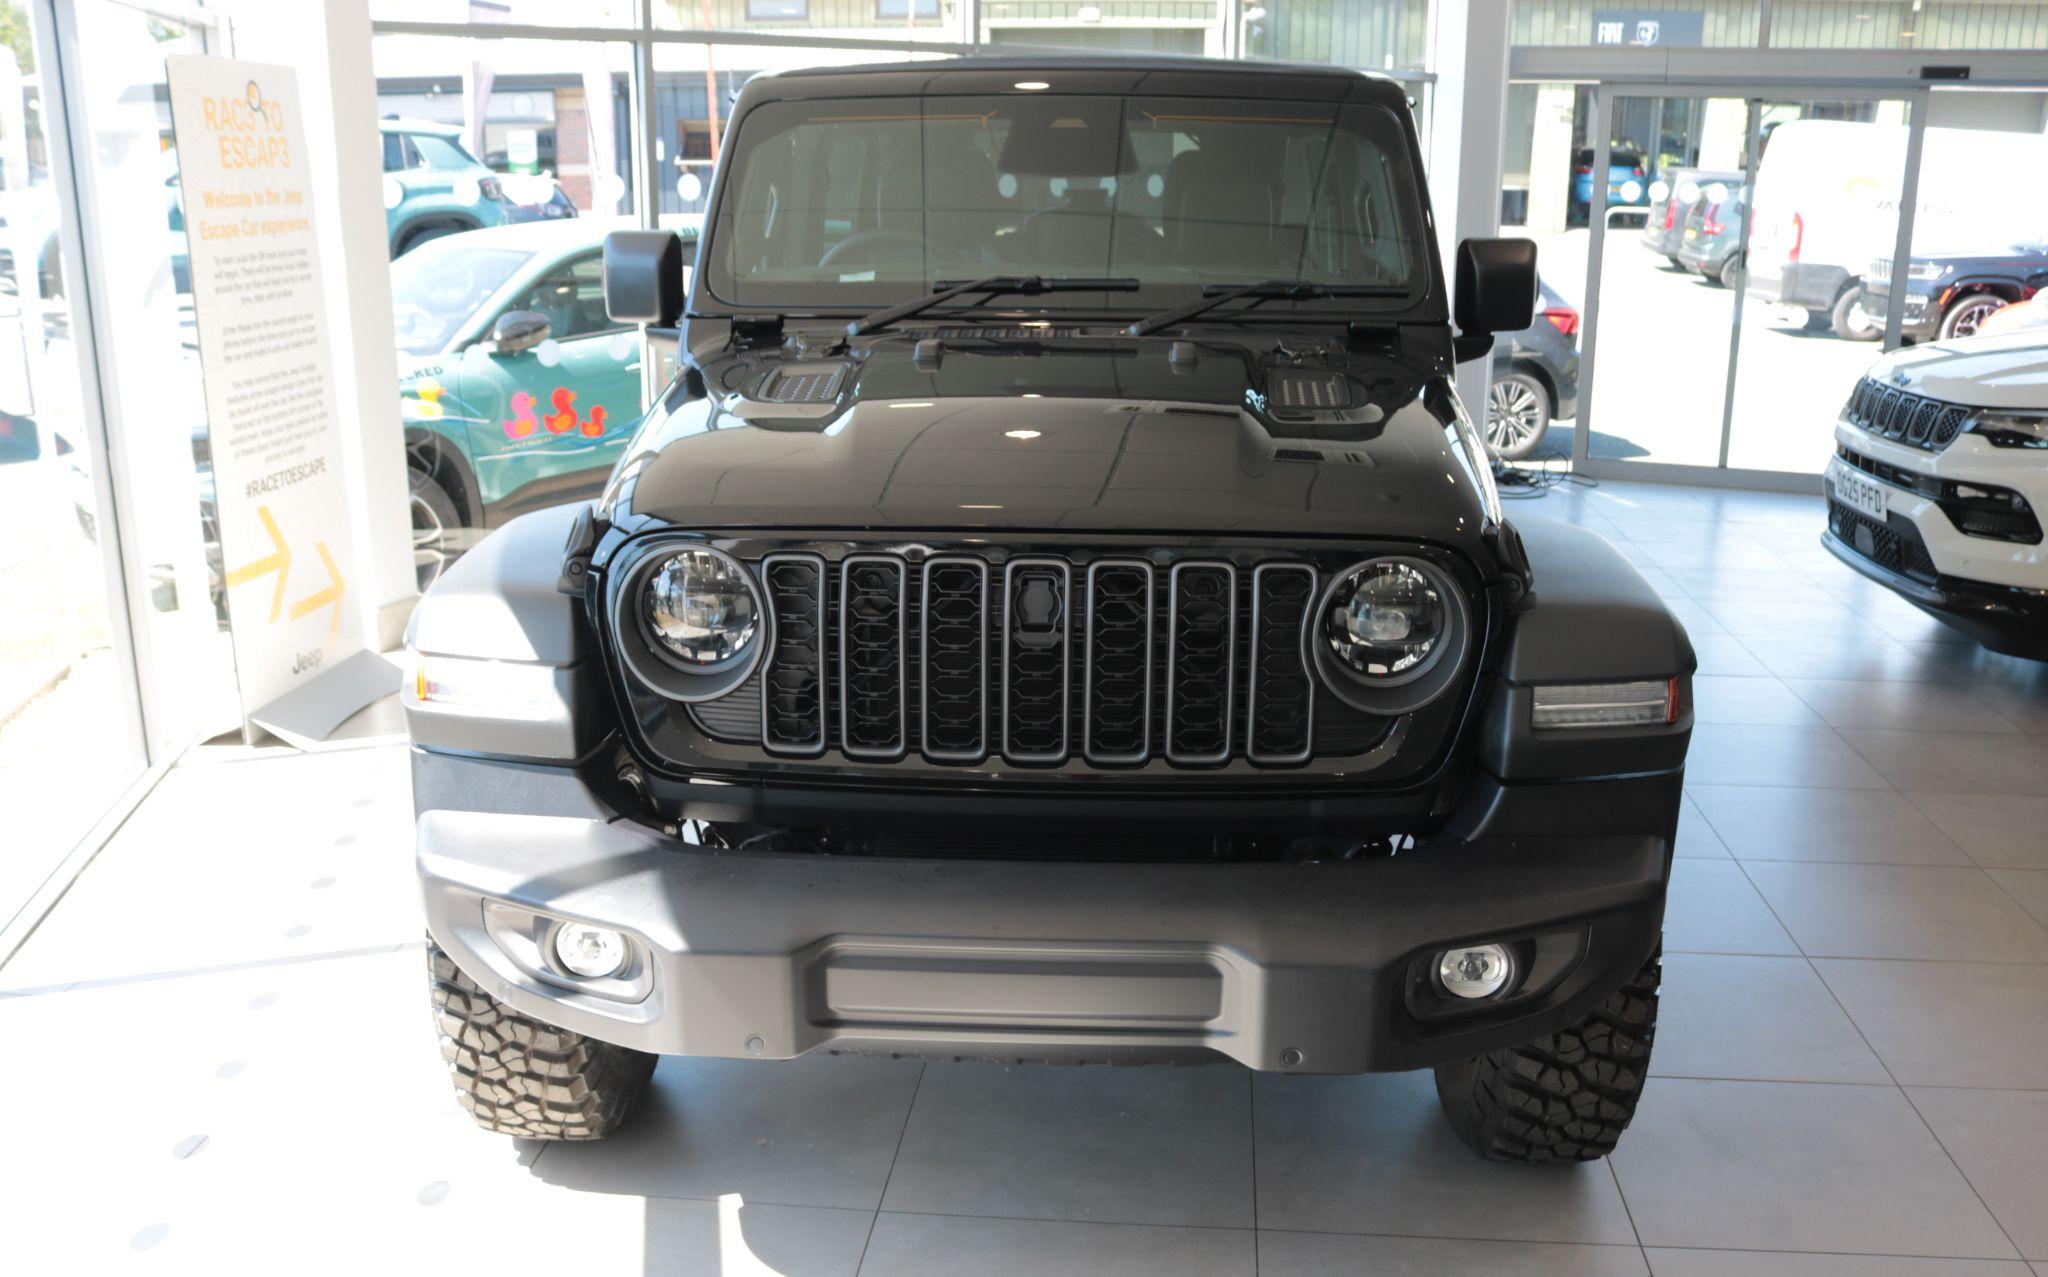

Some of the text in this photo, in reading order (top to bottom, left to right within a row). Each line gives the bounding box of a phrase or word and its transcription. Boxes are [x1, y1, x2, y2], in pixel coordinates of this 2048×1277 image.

[1597, 21, 1624, 44] FIAT
[261, 98, 285, 132] TO
[218, 135, 291, 170] ESCAP3
[202, 187, 303, 208] Welcome to the Jeep
[199, 219, 240, 242] Escape
[241, 217, 258, 237] Car
[245, 456, 327, 499] #RACETOESCAPE
[292, 648, 322, 675] Jeep
